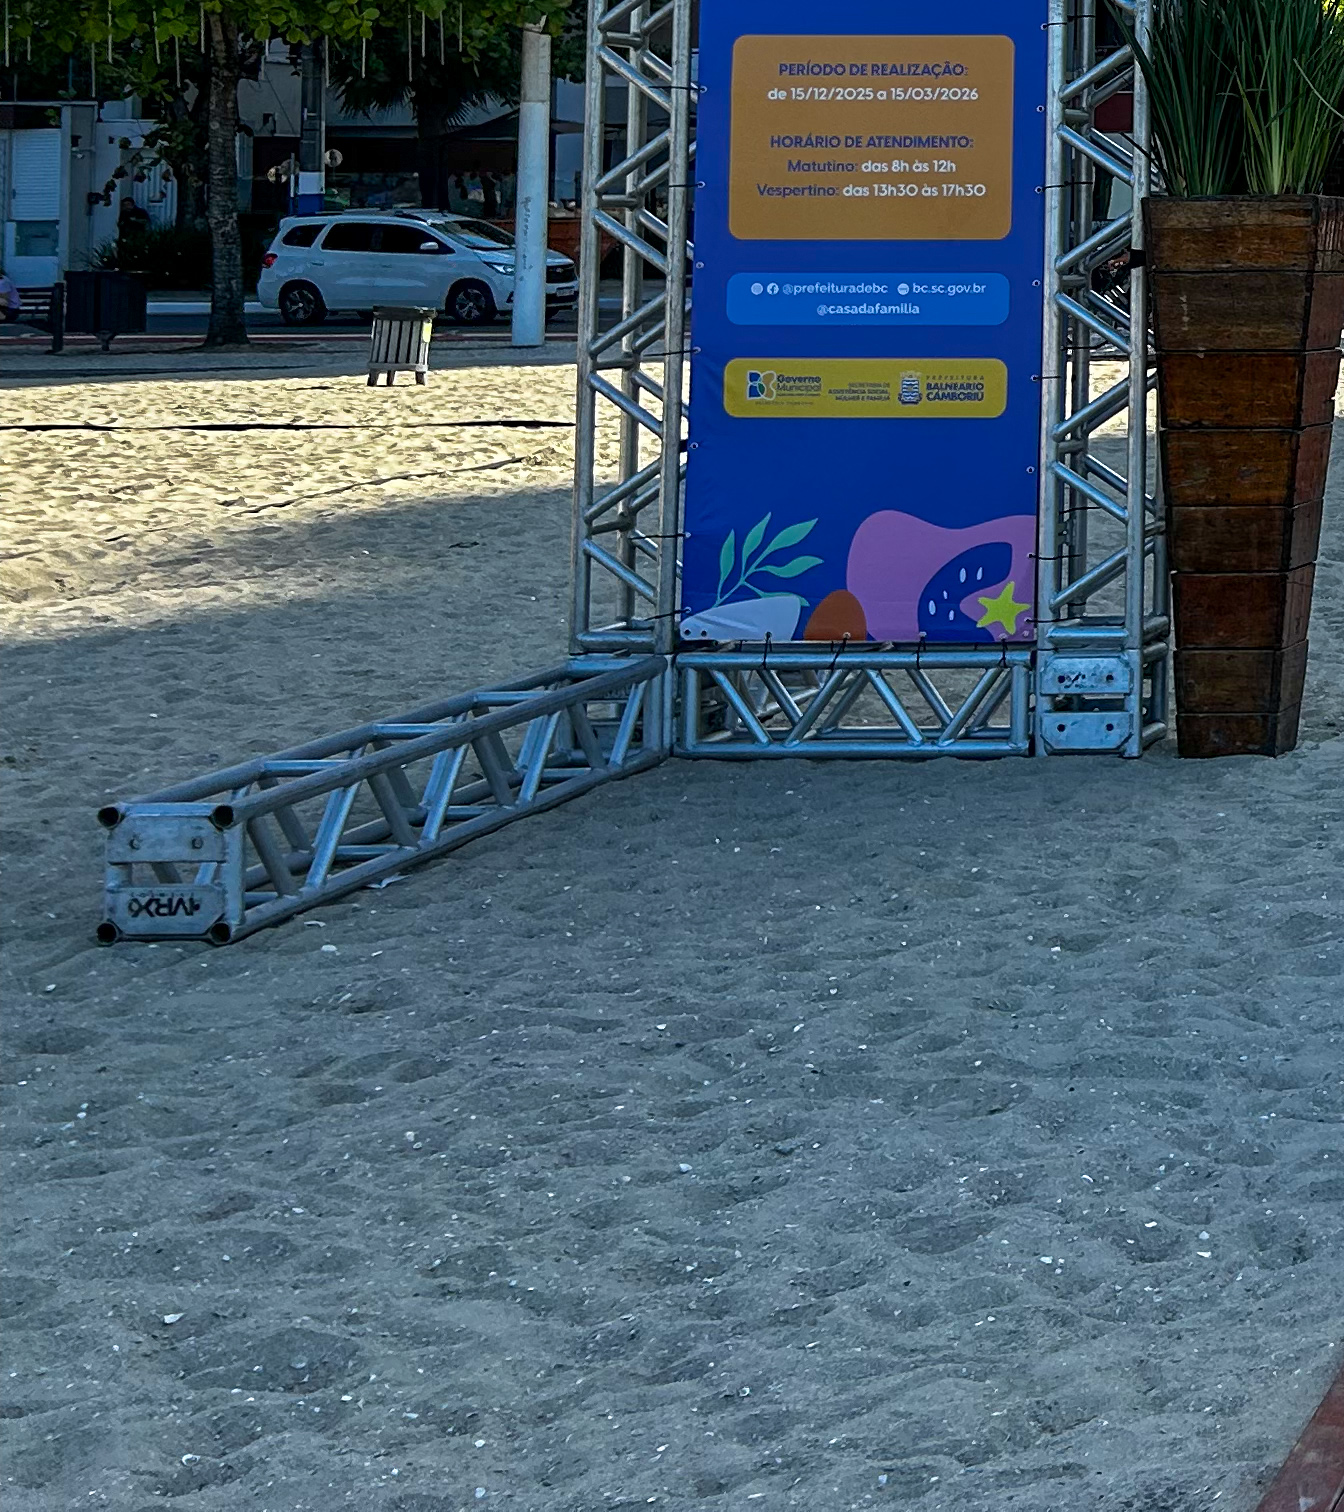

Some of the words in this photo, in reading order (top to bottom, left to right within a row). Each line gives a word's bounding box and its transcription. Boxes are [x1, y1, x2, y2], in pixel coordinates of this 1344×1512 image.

[778, 60, 846, 76] PERÍODO
[849, 63, 868, 76] DE
[871, 60, 969, 80] REALIZAÇÃO:
[767, 88, 787, 101] de
[790, 87, 874, 102] 15/12/2025
[876, 90, 888, 101] a
[890, 87, 979, 102] 15/03/2026
[770, 133, 842, 148] HORÁRIO
[845, 136, 863, 148] DE
[866, 135, 975, 148] ATENDIMENTO:
[787, 160, 858, 173] Matutino:
[861, 160, 889, 173] das
[891, 160, 909, 173] 8h
[912, 161, 930, 173] às
[932, 160, 957, 173] 12h
[756, 183, 840, 199] Vespertino:
[842, 184, 870, 197] das
[873, 184, 919, 197] 13h30
[921, 184, 939, 197] às
[941, 184, 986, 197] 17h30
[782, 282, 889, 295] @prefeituradebc
[912, 282, 987, 296] bc.sc.gov.br
[776, 374, 822, 383] Governo
